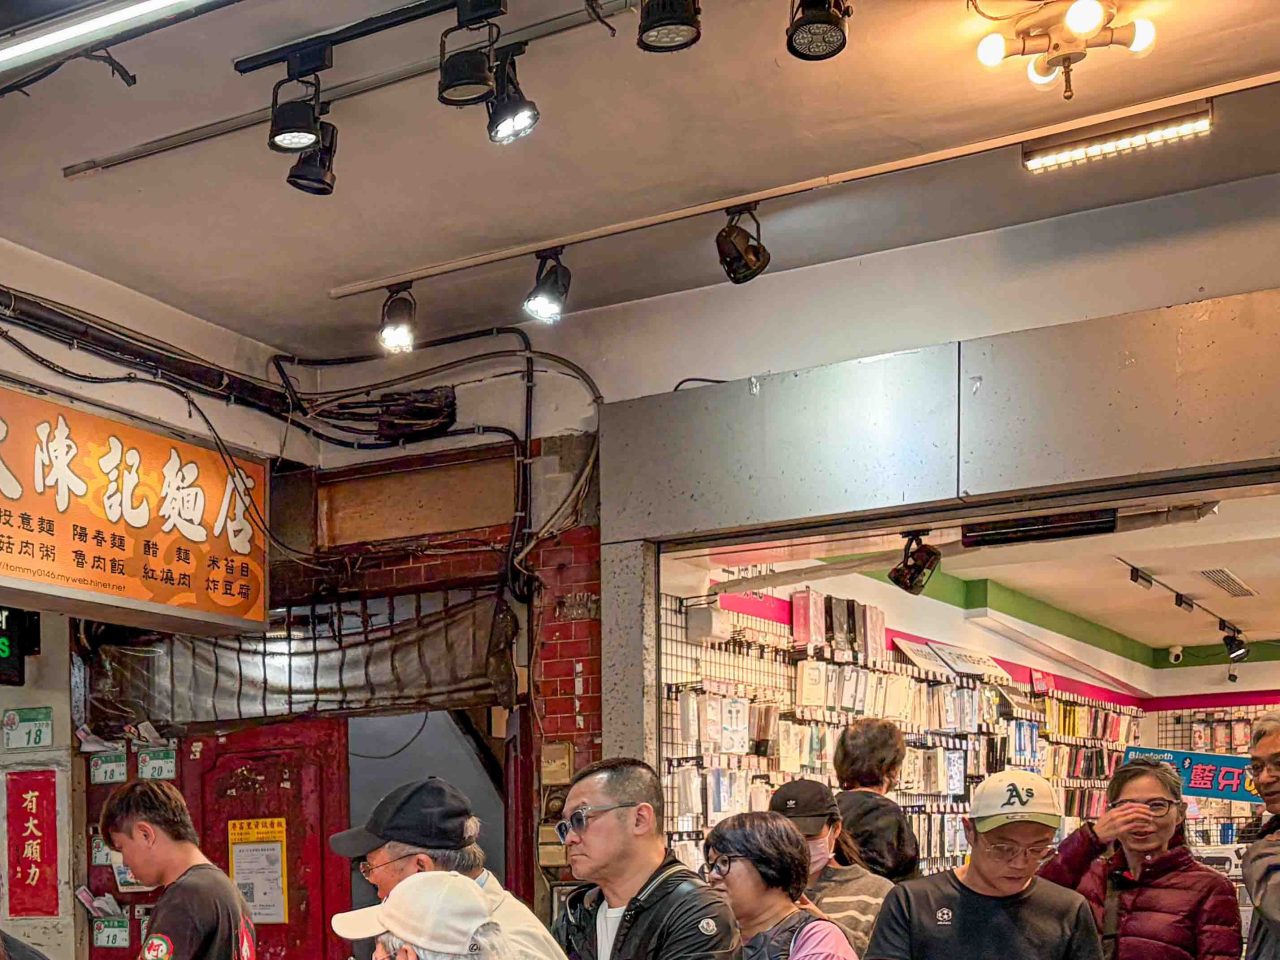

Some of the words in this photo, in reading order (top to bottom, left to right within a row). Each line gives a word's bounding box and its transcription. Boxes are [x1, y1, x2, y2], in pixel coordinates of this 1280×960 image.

[72, 523, 126, 552] 陽春麵
[207, 555, 250, 578] 米苔目
[72, 549, 126, 576] 魯肉飯
[142, 563, 191, 589] 紅燒肉
[205, 576, 251, 600] 炸豆腐
[25, 728, 42, 746] 18
[104, 769, 115, 781] 18
[151, 766, 163, 778] 20
[1001, 782, 1035, 808] A's
[21, 789, 43, 887] 有大願力
[106, 934, 118, 945] 18
